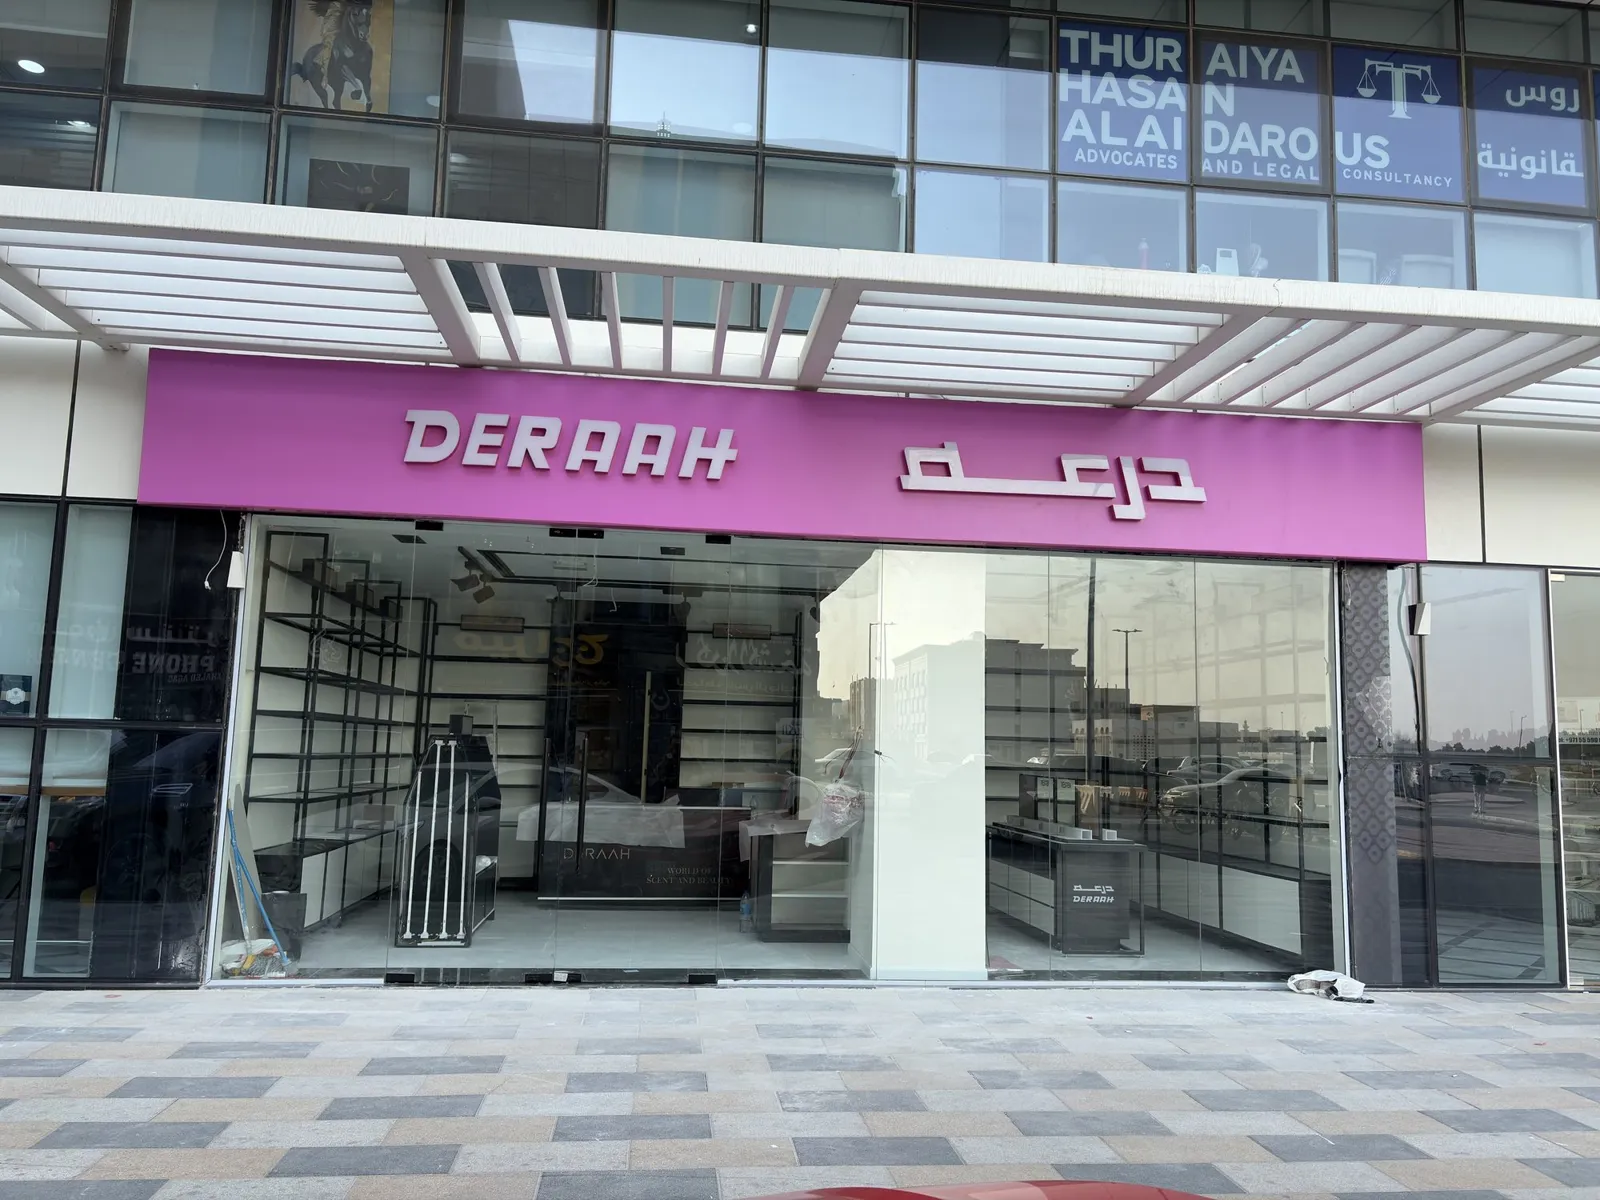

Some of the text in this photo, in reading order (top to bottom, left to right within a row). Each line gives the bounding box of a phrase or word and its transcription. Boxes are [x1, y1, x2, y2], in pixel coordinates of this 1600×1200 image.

[1074, 147, 1453, 188] ADVOCATES AND LEGAL CONSULTANCY
[403, 409, 739, 481] DERAAH
[563, 847, 630, 860] DRAAH
[1073, 895, 1115, 903] DERAAH
